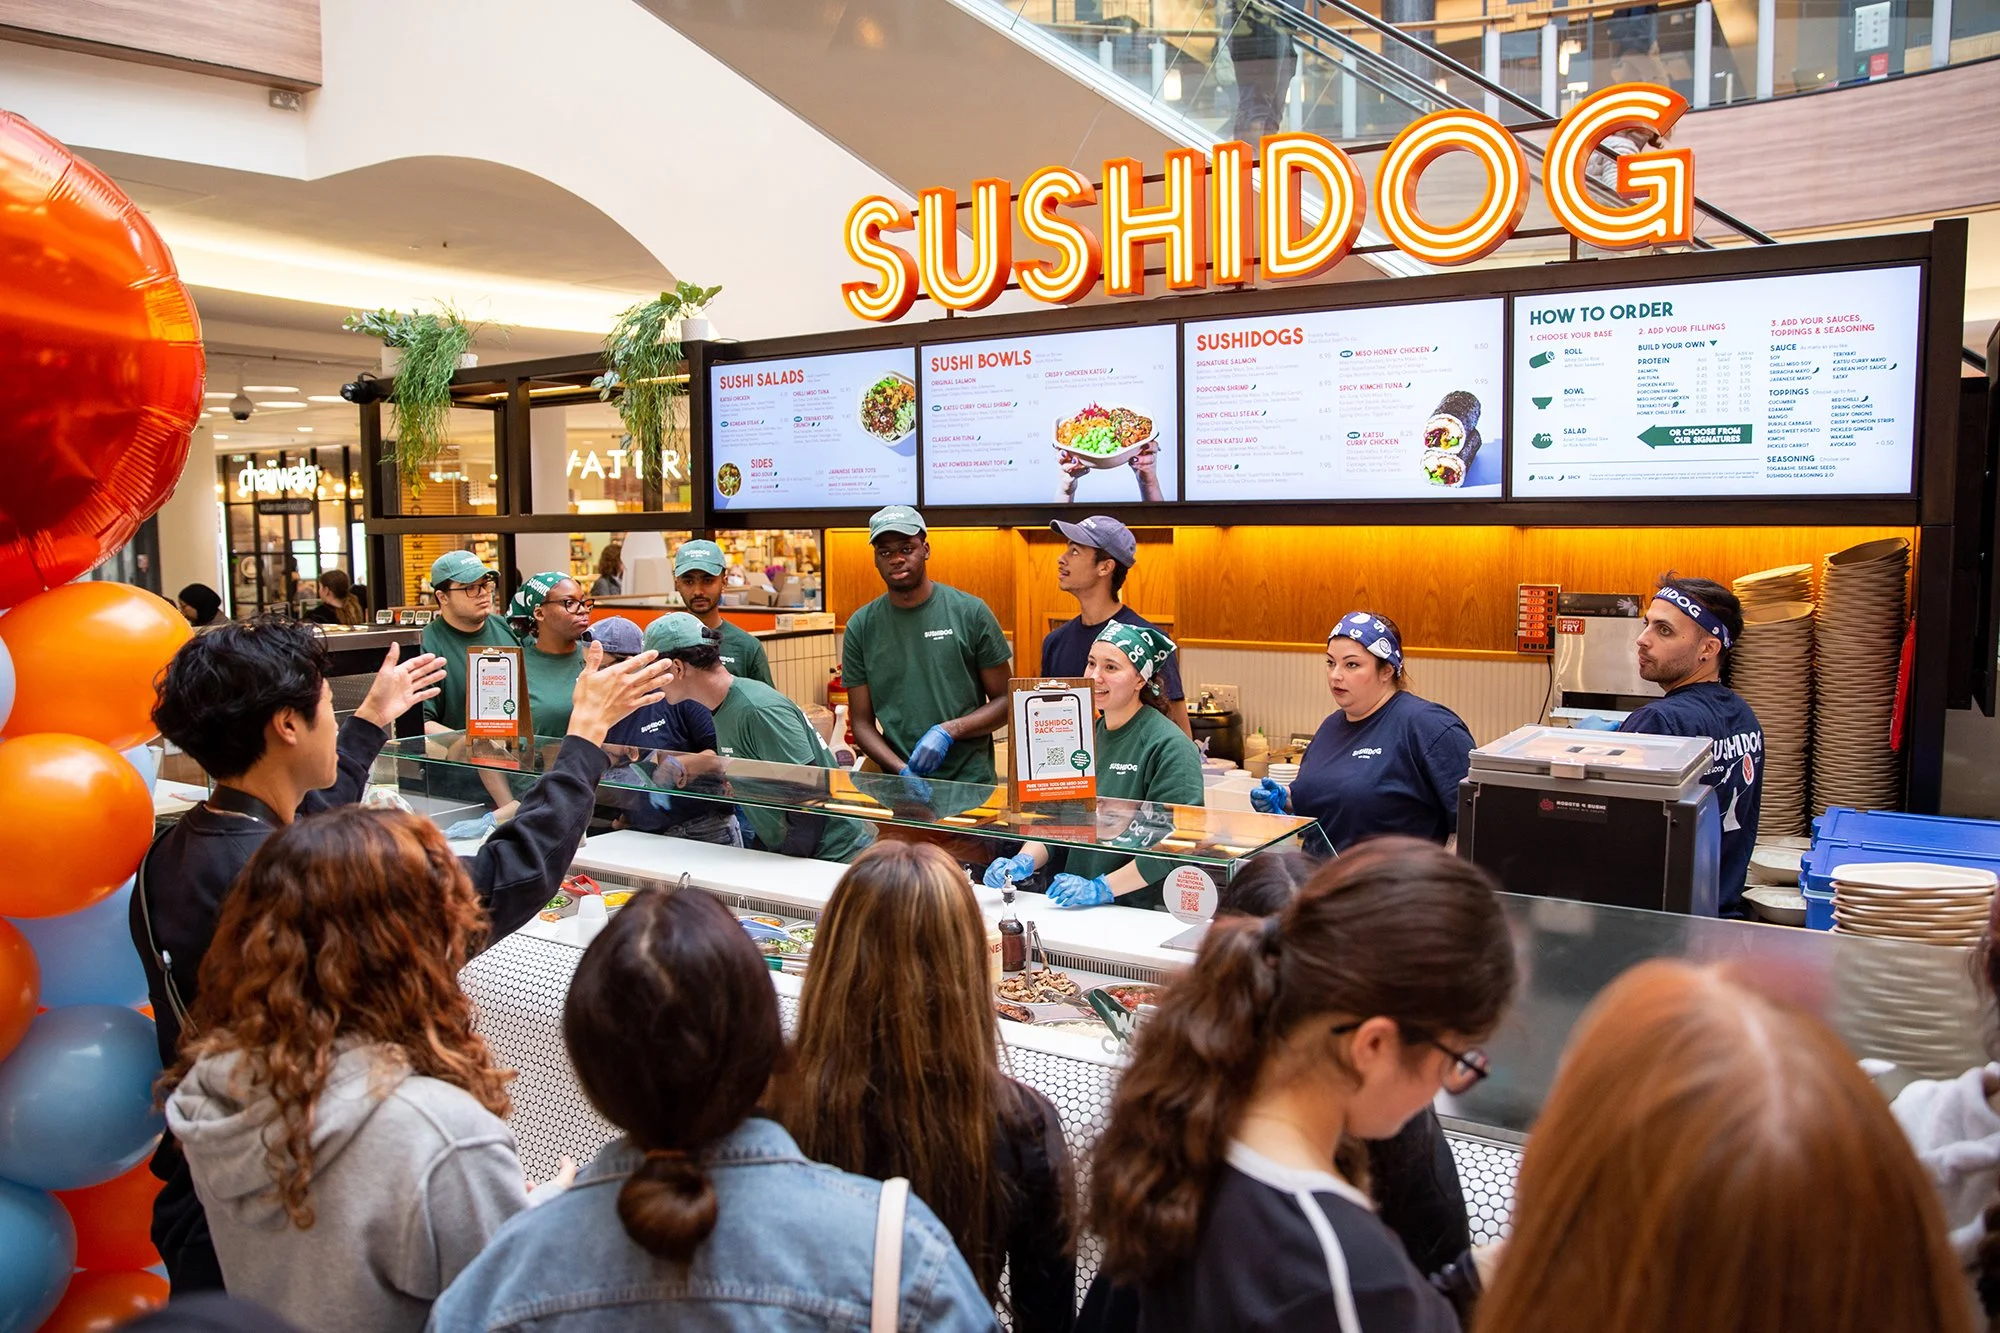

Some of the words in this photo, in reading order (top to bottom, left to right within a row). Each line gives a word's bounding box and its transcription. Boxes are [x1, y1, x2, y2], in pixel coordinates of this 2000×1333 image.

[841, 82, 1695, 322] SUSHIDOG
[1530, 308, 1575, 325] HOW
[1580, 306, 1605, 322] TO
[1610, 302, 1673, 320] ORDER
[1827, 314, 1862, 324] SAUCES,
[1690, 323, 1726, 332] FILLINGS
[1771, 328, 1812, 337] TOPPINGS
[1824, 324, 1875, 333] SEASONING
[1196, 327, 1304, 351] SUSHIDOGS
[932, 354, 973, 372] SUSHI
[978, 349, 1032, 368] BOWLS
[1196, 359, 1228, 367] SIGNATURE
[720, 374, 753, 390] SUSHI
[757, 369, 804, 387] SALADS
[1769, 388, 1809, 396] TOPPINGS
[1682, 427, 1716, 436] CHOOSE
[1693, 435, 1740, 443] SIGNATURES
[751, 458, 773, 468] SIDES
[924, 628, 953, 638] SUSHIDOG
[1035, 719, 1073, 727] SUSHIDOG
